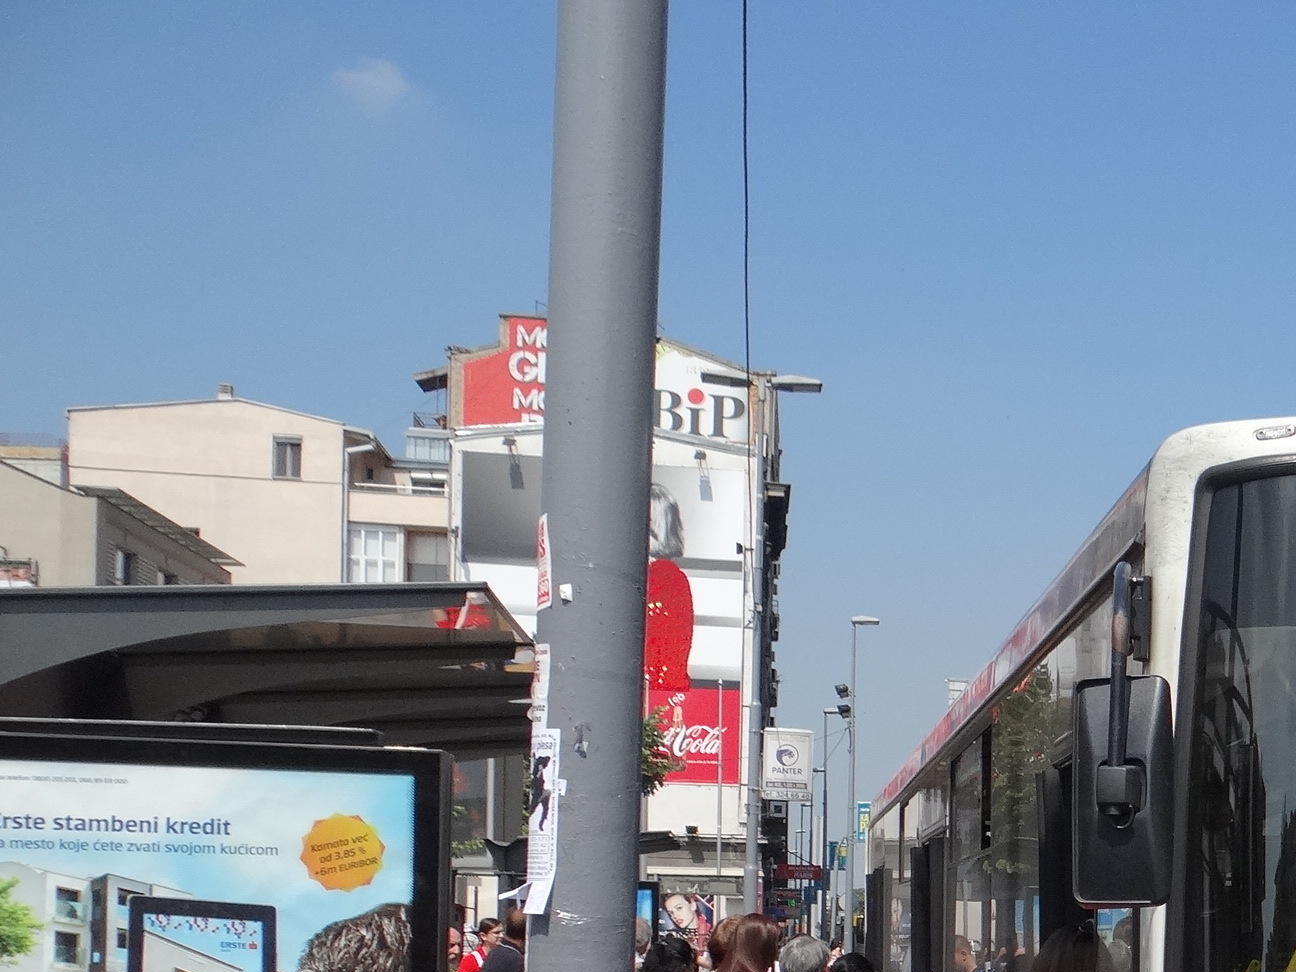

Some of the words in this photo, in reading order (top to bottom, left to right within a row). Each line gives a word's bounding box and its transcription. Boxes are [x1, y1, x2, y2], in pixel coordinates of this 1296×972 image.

[771, 766, 803, 775] PANTER
[0, 813, 46, 831] rste
[53, 815, 158, 834] stambeni
[166, 817, 231, 836] kredit
[9, 840, 55, 851] mesto
[59, 838, 88, 854] koje
[93, 839, 122, 852] ćete
[127, 842, 160, 853] zvati
[165, 843, 215, 856] svojom
[220, 842, 279, 857] kućicom
[320, 853, 332, 864] od
[339, 856, 378, 873] EURIBOR
[221, 941, 246, 949] ERSTE
